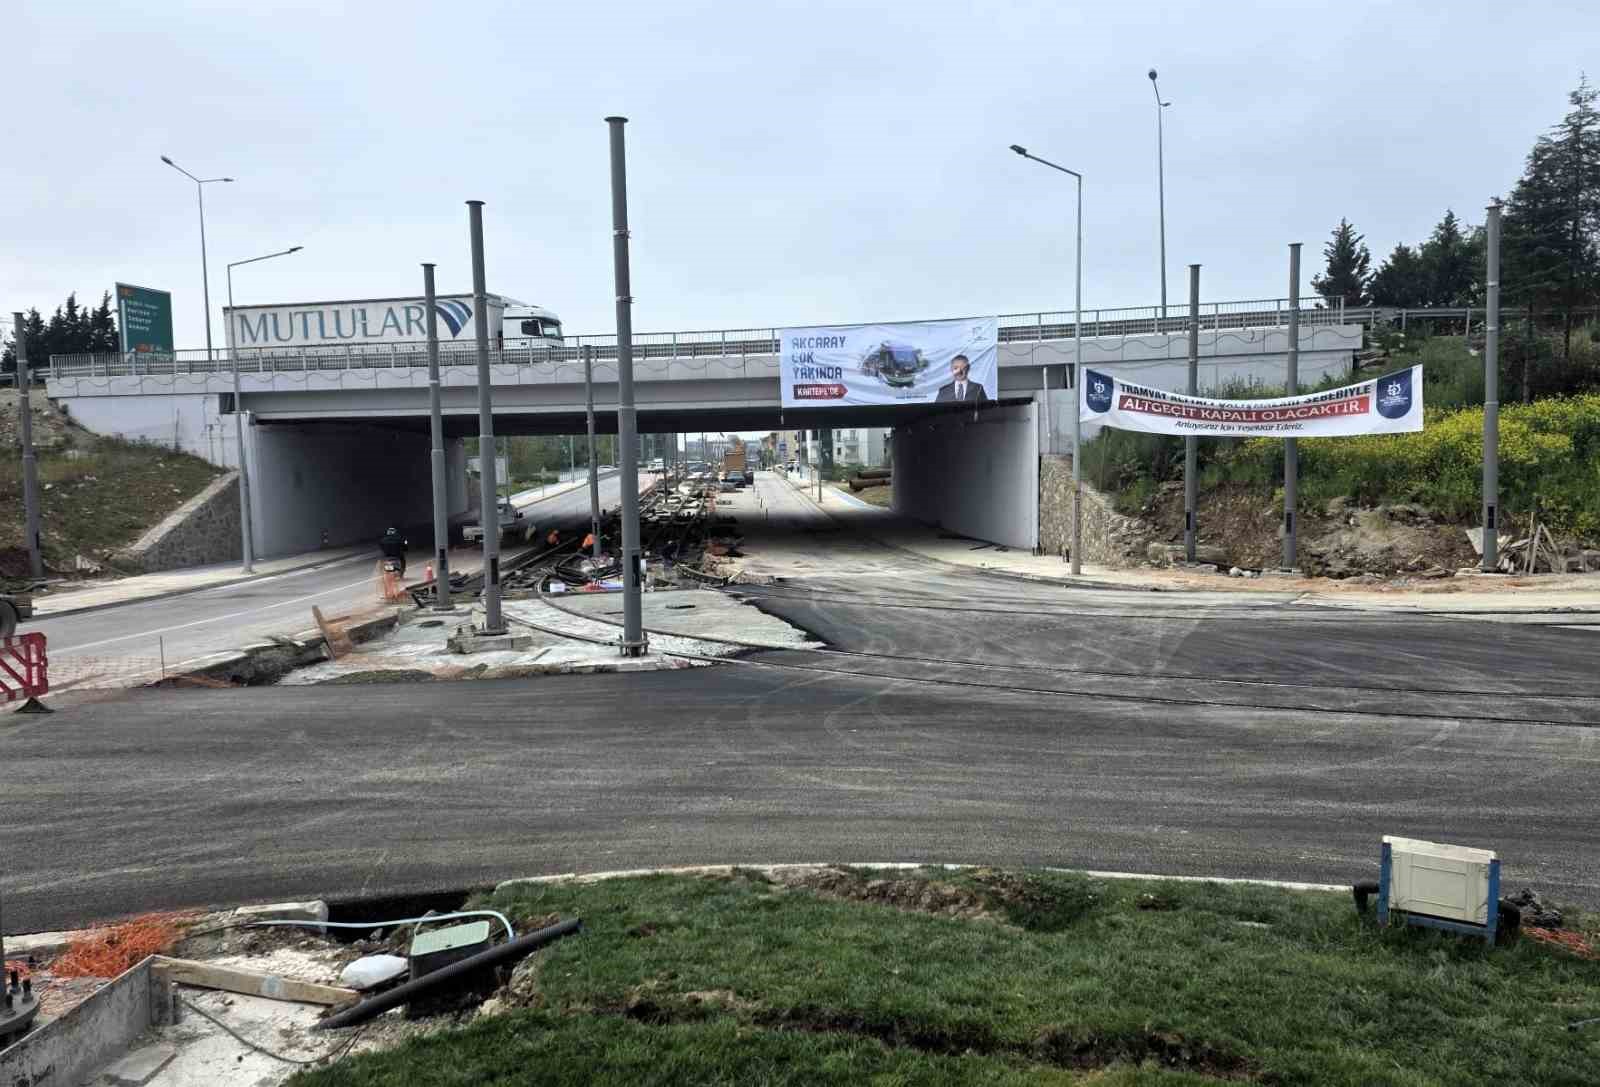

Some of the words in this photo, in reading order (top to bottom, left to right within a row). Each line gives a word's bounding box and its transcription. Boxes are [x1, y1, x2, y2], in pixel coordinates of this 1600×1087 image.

[239, 305, 427, 344] MUTLULAR
[792, 367, 843, 380] YAKINDA
[1200, 409, 1257, 422] KAPALI
